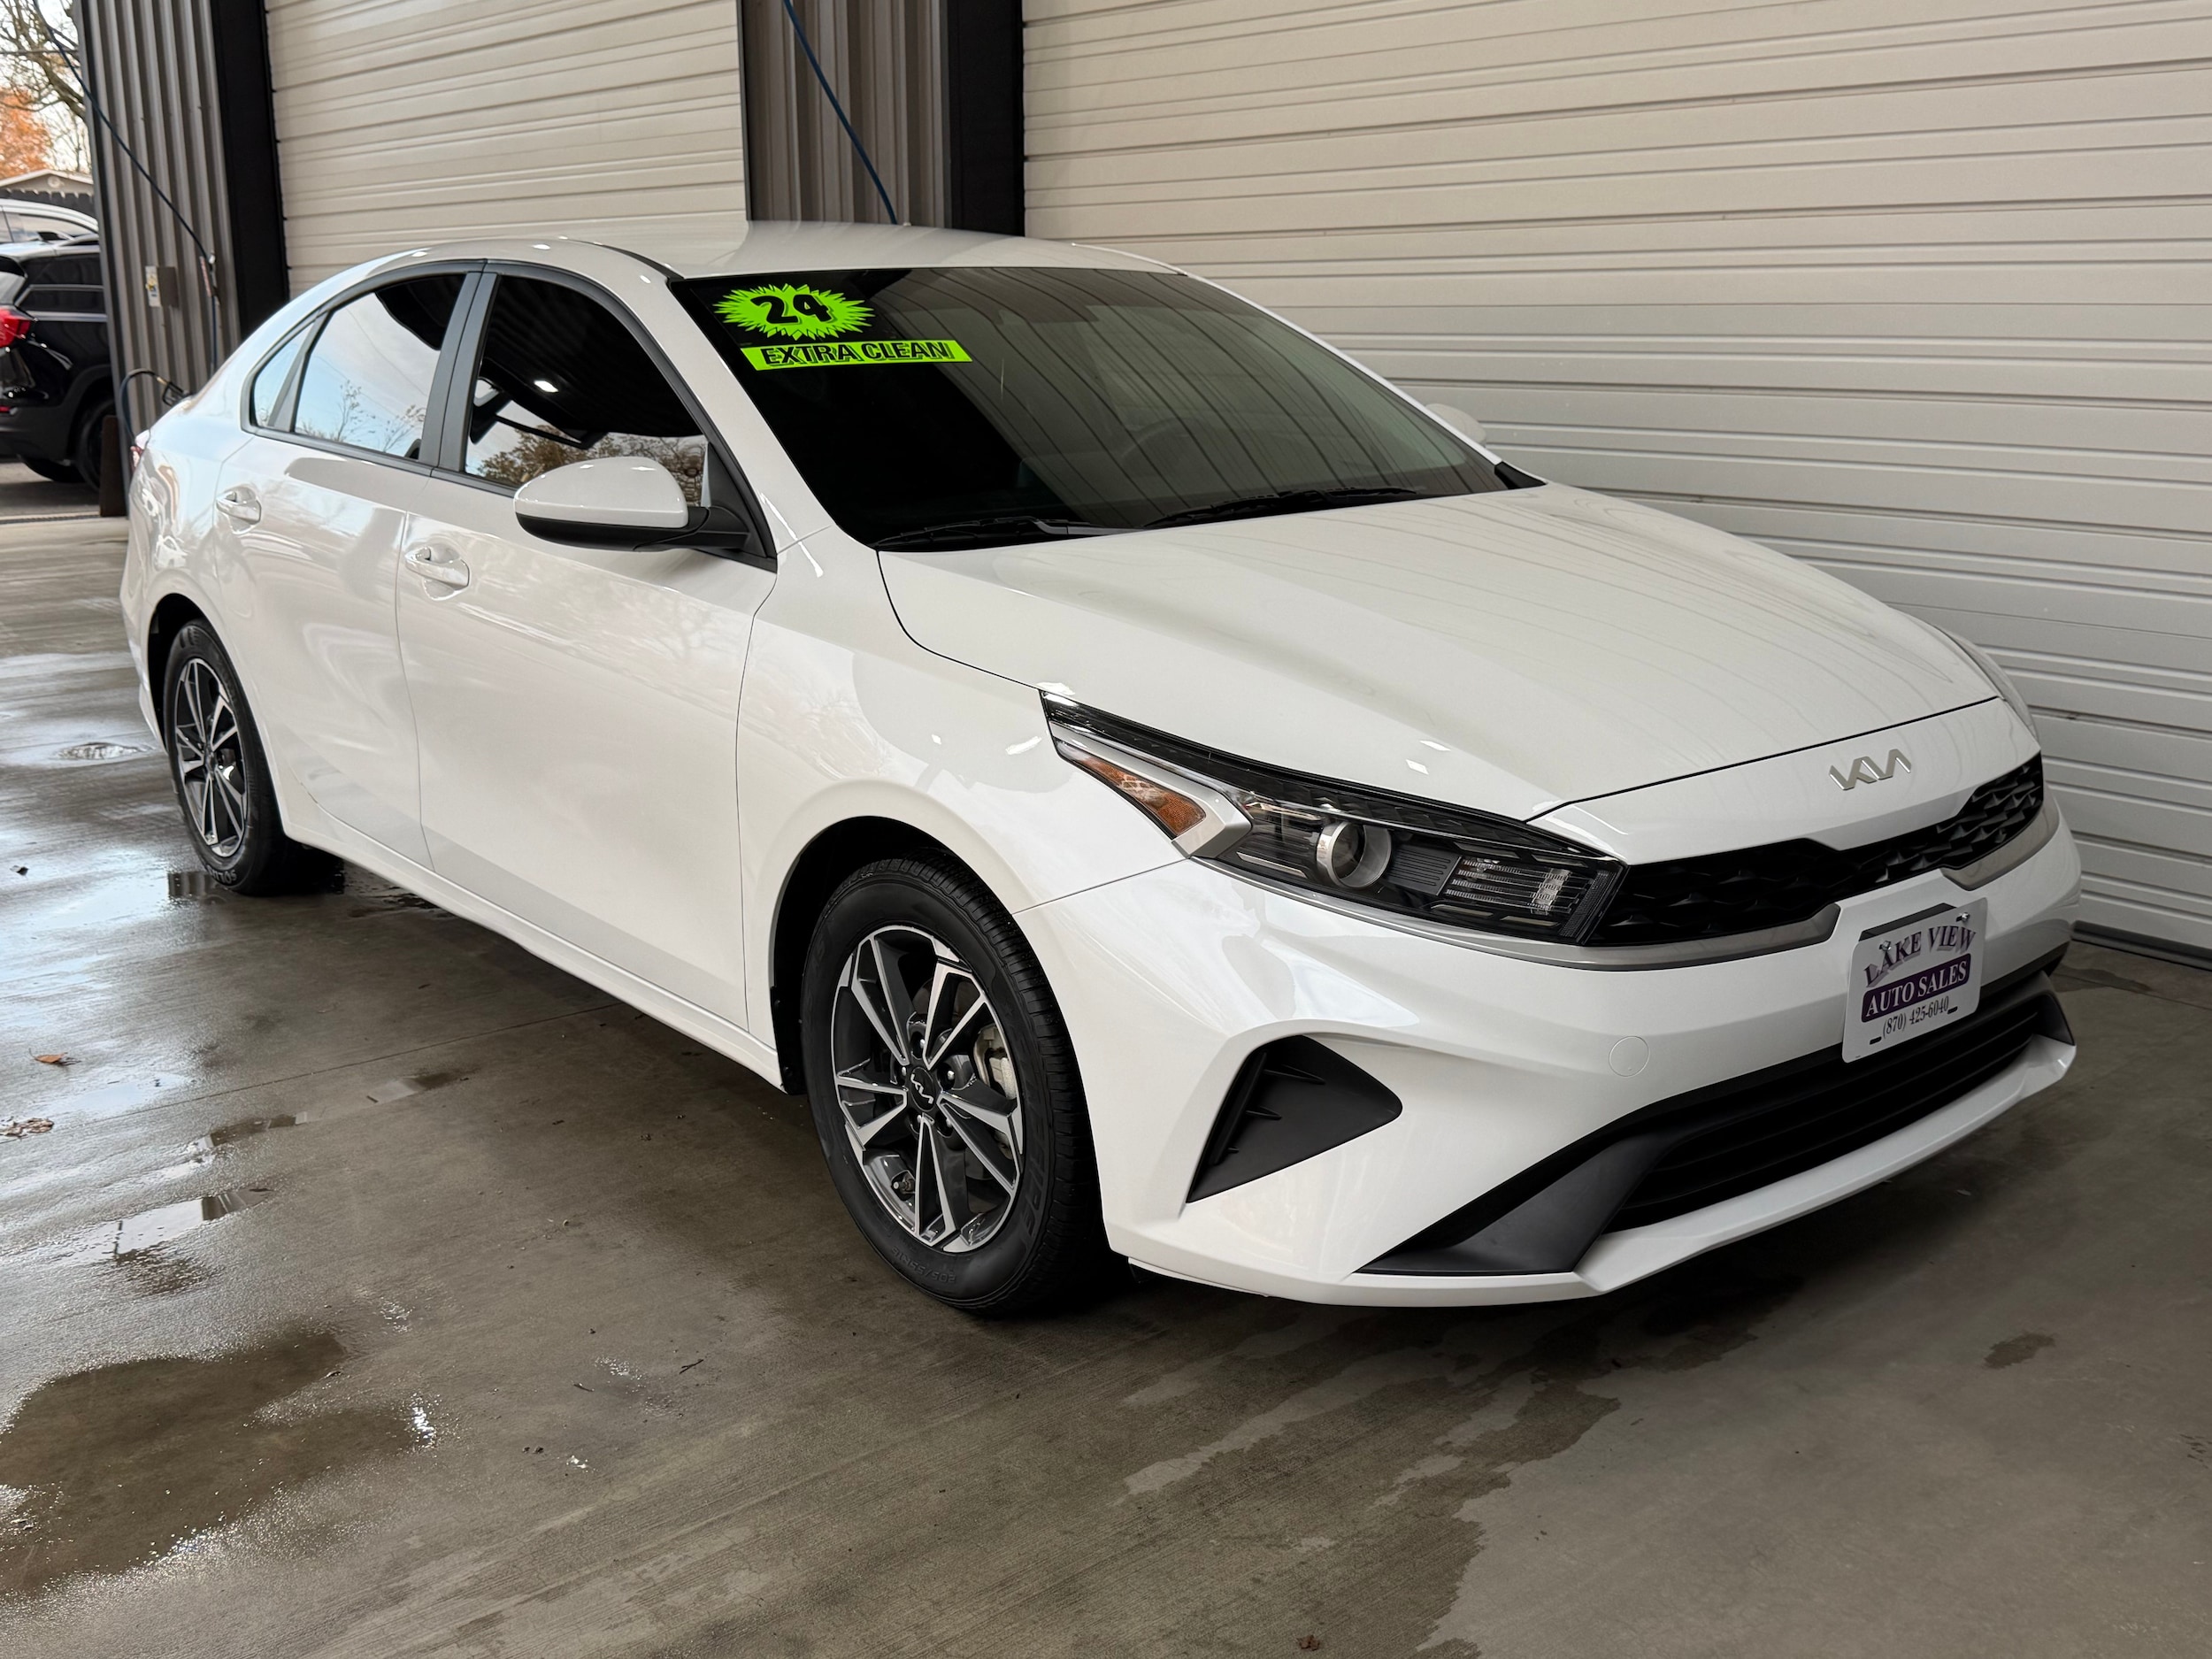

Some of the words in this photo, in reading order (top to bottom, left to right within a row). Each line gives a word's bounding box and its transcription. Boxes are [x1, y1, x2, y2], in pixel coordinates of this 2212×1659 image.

[750, 294, 833, 325] 24
[761, 342, 861, 365] EXTRA
[861, 342, 954, 361] CLEAN
[1829, 749, 1912, 790] KIA
[1863, 931, 1922, 987] LAKE
[1928, 926, 1977, 953] VIEW
[1866, 981, 1915, 1017] AUTO
[1917, 961, 1967, 997] SALES
[1883, 1014, 1907, 1039] (870)
[1909, 995, 1949, 1025] 425-6040
[910, 1073, 934, 1105] KIA
